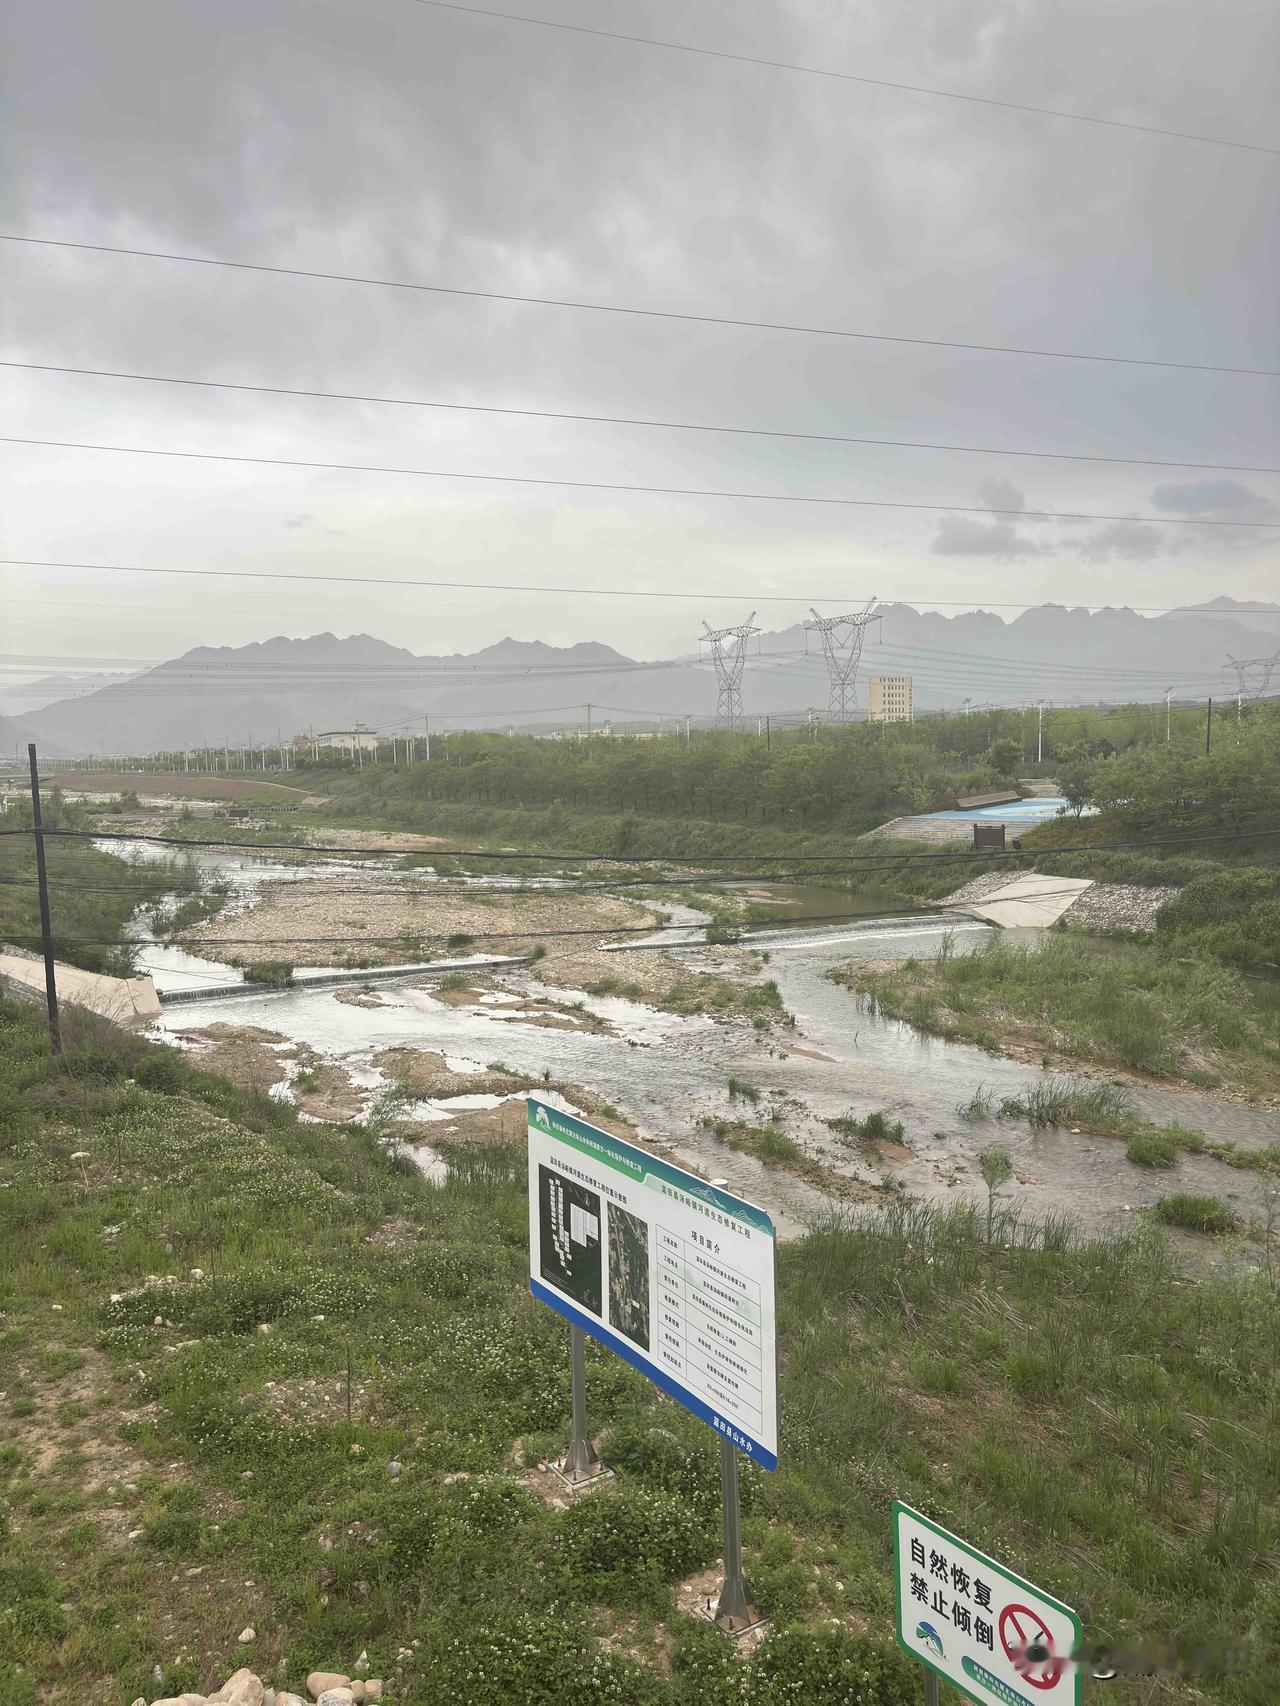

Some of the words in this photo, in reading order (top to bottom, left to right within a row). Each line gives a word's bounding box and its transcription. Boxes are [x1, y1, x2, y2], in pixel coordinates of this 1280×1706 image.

[691, 1230, 720, 1254] 项目简介
[713, 1416, 753, 1452] 蓝田县山水办
[910, 1537, 993, 1614] 自然恢复
[910, 1572, 994, 1651] 禁止倾倒
